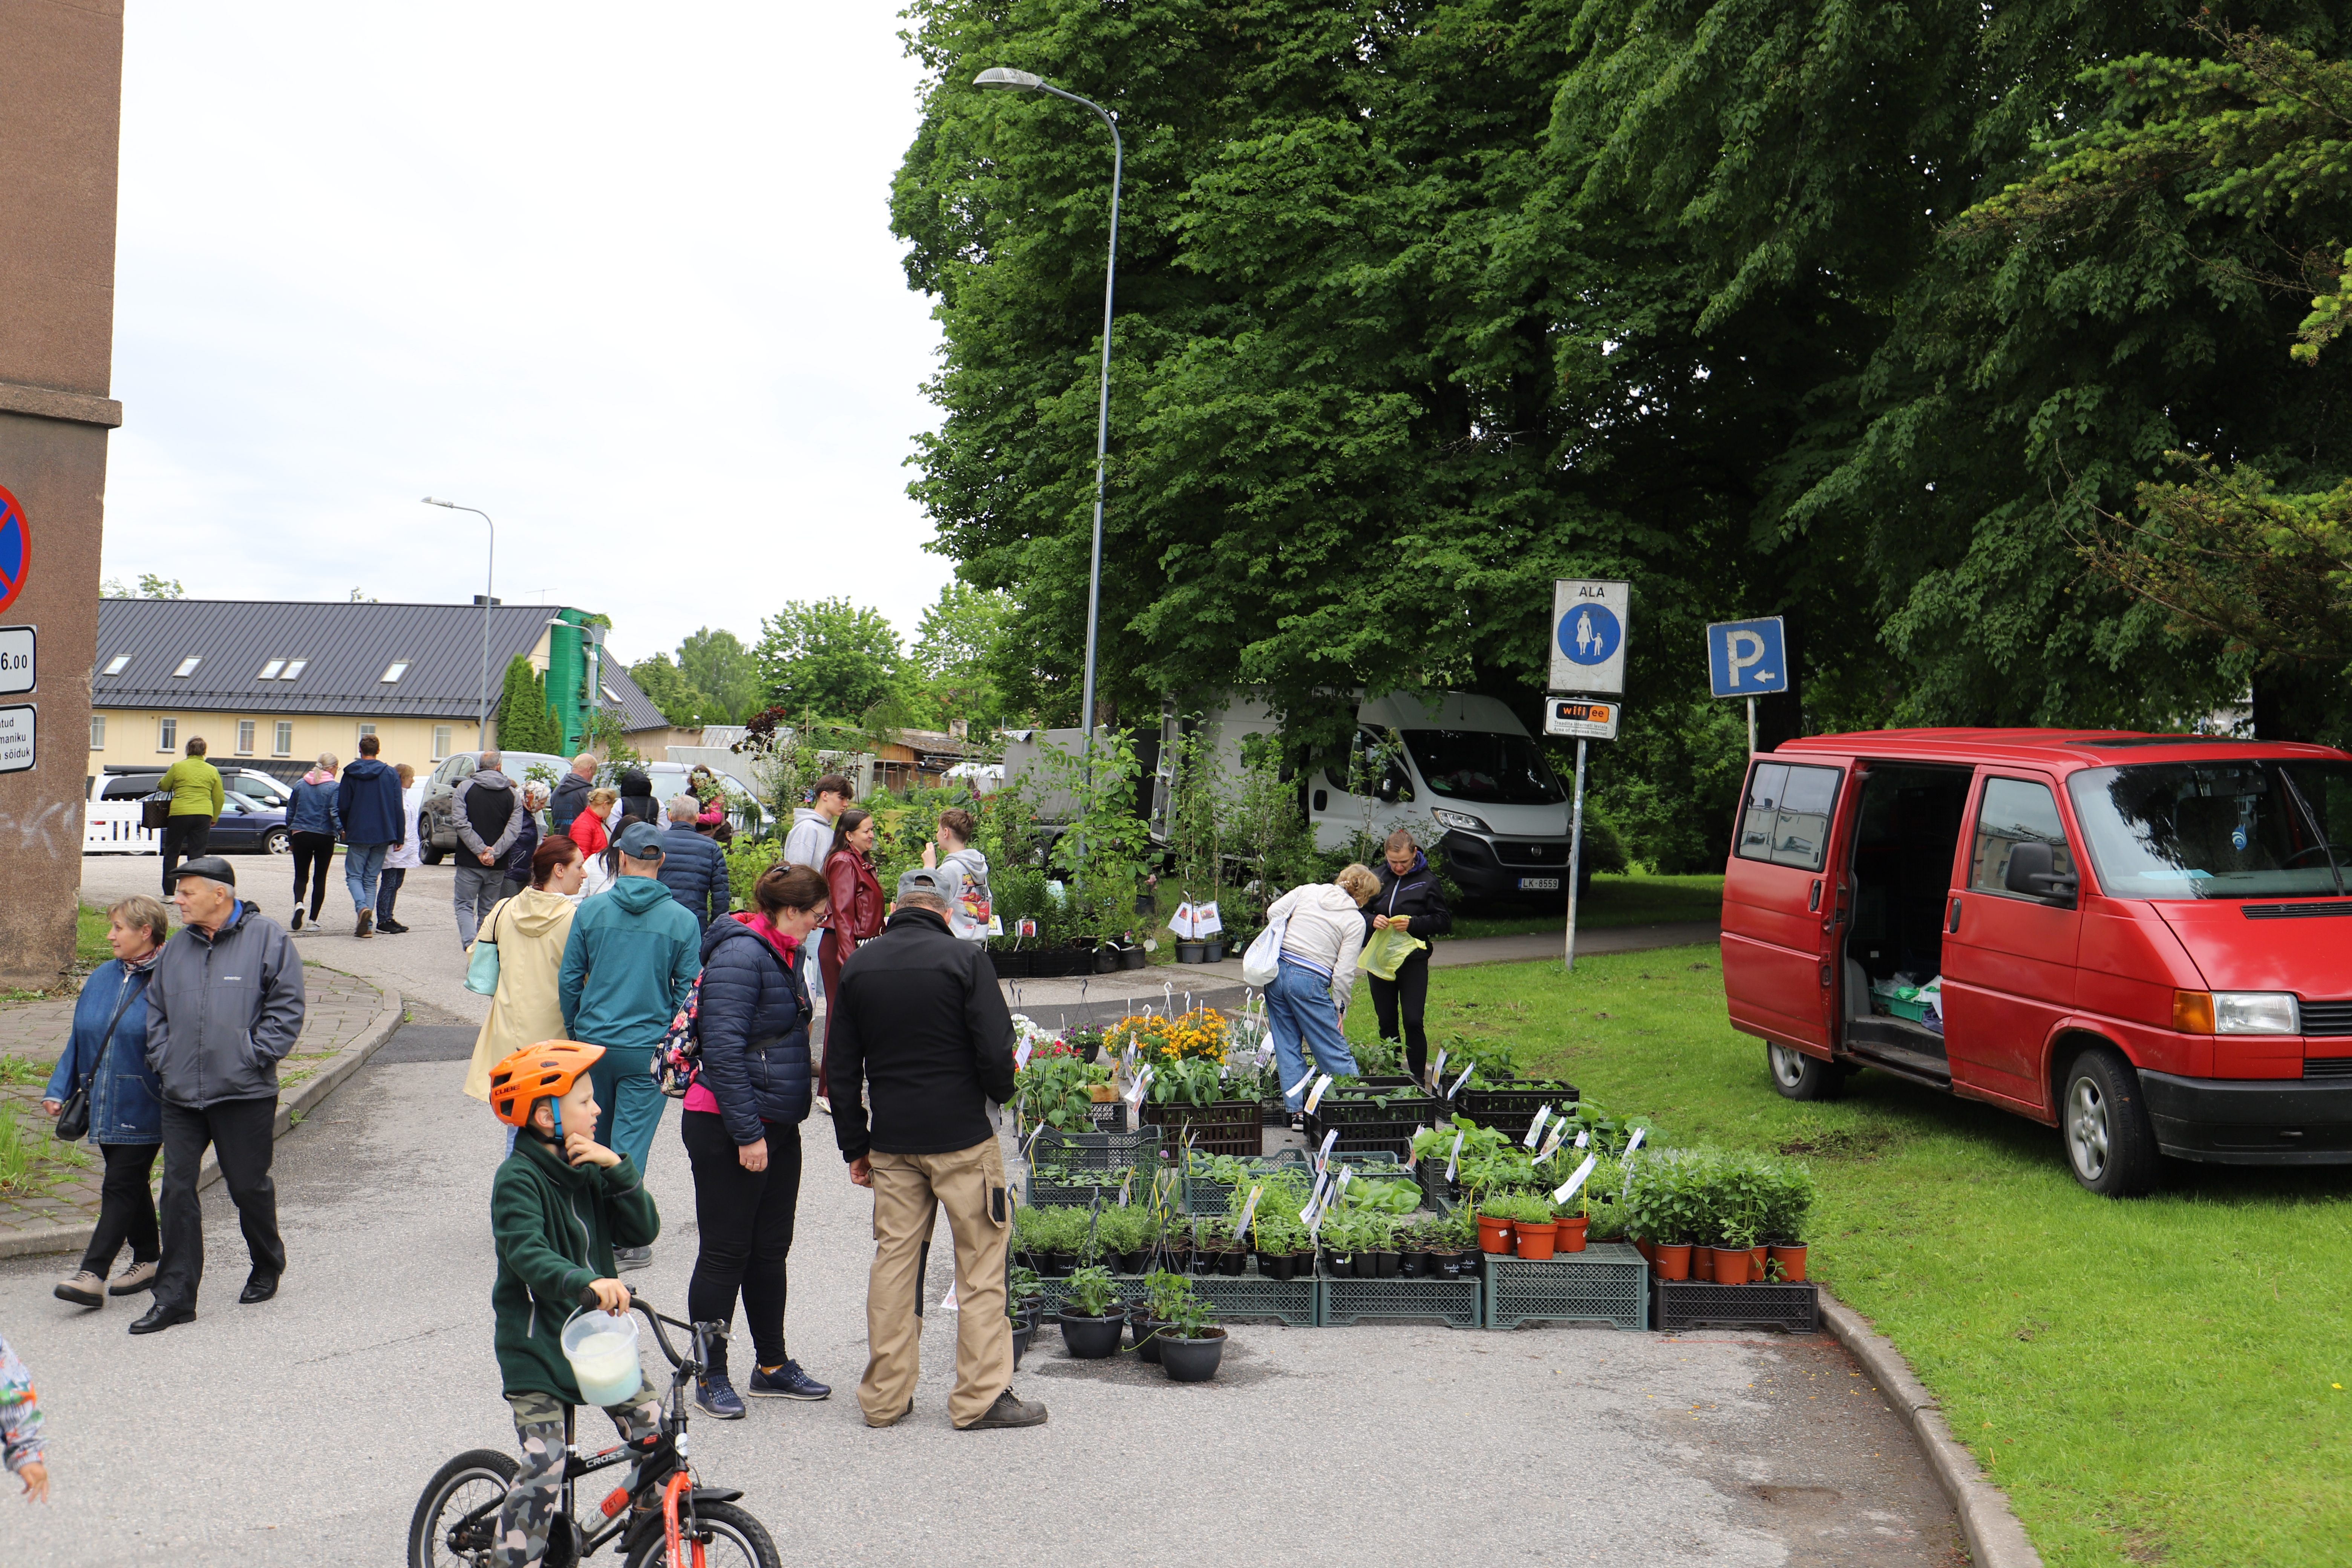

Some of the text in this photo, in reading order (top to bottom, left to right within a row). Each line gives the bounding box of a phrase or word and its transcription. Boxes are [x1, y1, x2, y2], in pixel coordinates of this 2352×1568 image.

[1579, 586, 1605, 597] ALA
[1726, 629, 1765, 687] P
[1563, 706, 1586, 716] wifi
[5, 747, 30, 760] sõiduk
[1523, 879, 1557, 888] LK-8559
[495, 1084, 520, 1096] CUBE
[586, 1449, 625, 1468] CROSS
